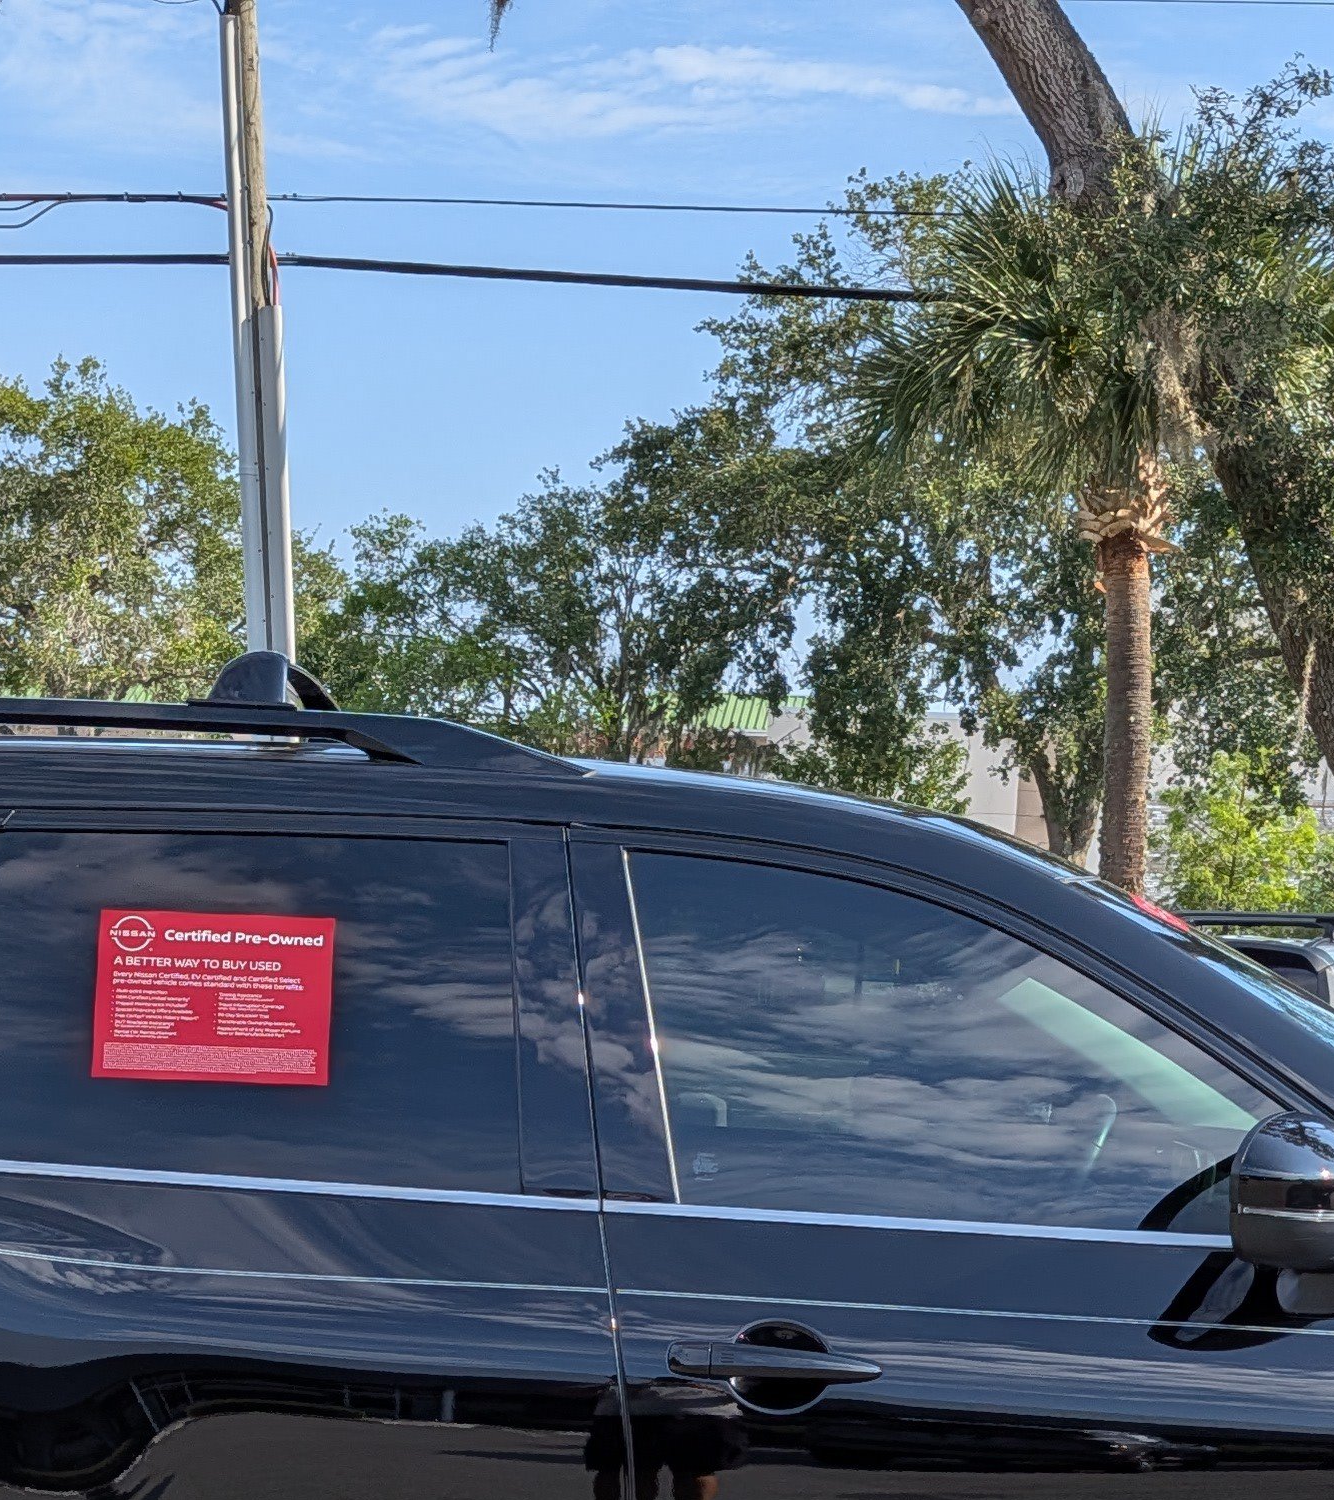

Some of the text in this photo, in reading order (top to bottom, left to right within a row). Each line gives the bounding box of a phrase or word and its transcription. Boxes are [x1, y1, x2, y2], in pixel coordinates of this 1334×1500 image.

[109, 929, 156, 938] NISSAN
[164, 929, 324, 947] Certified Pre-Owned
[113, 955, 282, 972] A BETTER WAY TO BUY USED
[113, 971, 133, 979] Every
